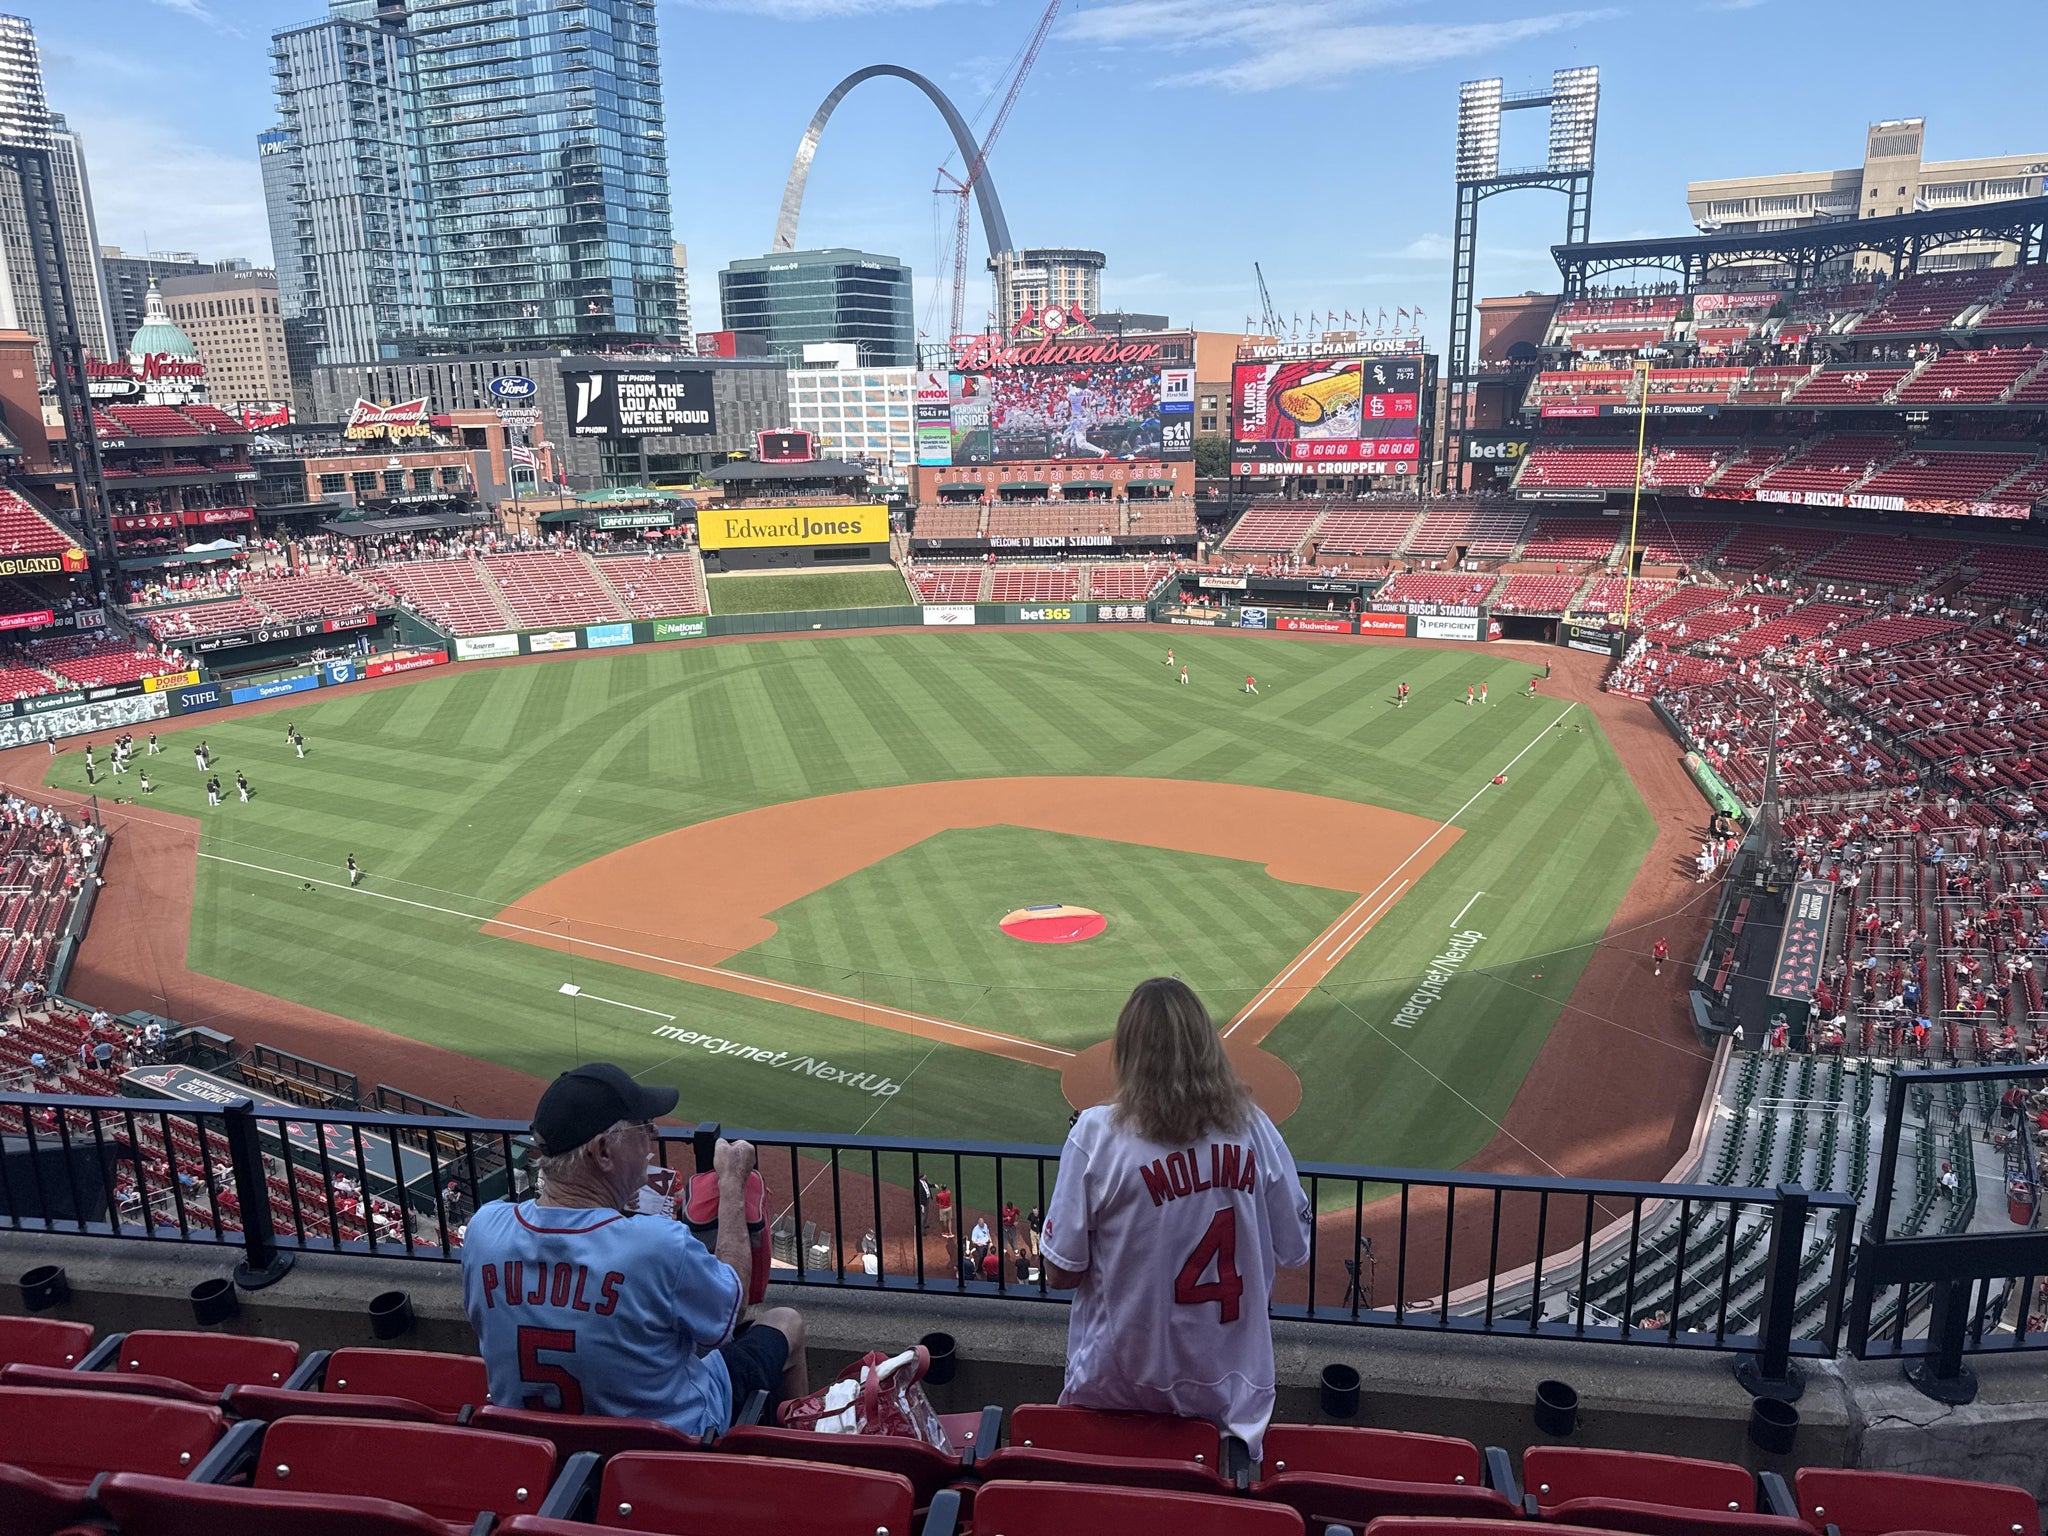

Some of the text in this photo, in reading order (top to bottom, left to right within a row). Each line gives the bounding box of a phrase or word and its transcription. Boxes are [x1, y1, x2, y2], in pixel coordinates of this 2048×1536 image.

[1728, 294, 1777, 304] BUDWEISER
[950, 332, 1161, 371] Budweiser
[1252, 340, 1407, 358] WORLD CHAMPIONS
[135, 352, 204, 383] Nation
[145, 384, 194, 393] ROOFTOP
[499, 379, 529, 394] Ford
[617, 384, 685, 397] FROM THE
[918, 390, 948, 398] KMOX
[1256, 372, 1267, 425] CARDINALS
[619, 398, 677, 411] LOU AND
[955, 406, 988, 414] CARDINALS
[1243, 382, 1257, 432] ST. LOUIS
[1663, 405, 1704, 414] EDWARDS
[345, 407, 429, 424] Budweiser
[496, 408, 540, 418] Community
[619, 410, 709, 425] WE'RE PROUD
[955, 415, 989, 426] INSIDER
[348, 424, 431, 439] BREW HOUSE
[1313, 445, 1324, 455] GO
[1325, 445, 1336, 455] GO
[1337, 445, 1348, 454] GO
[1378, 444, 1389, 454] GO
[1390, 444, 1402, 454] GO
[1403, 444, 1414, 454] GO
[952, 470, 957, 481] 1
[962, 470, 969, 481] 2
[975, 469, 982, 480] 6
[988, 470, 995, 481] 9
[1000, 470, 1010, 481] 10
[1017, 470, 1028, 481] 14
[1034, 470, 1045, 481] 17
[1051, 470, 1063, 481] 20
[1072, 469, 1084, 480] 23
[1091, 469, 1104, 481] 24
[1110, 469, 1123, 480] 42
[1130, 468, 1143, 479] 45
[1259, 462, 1387, 474] BROWN & CROUPPEN
[1755, 490, 1904, 511] WELCOME TO BUSCH STADIUM
[603, 515, 670, 526] SAFETY NATIONAL
[725, 517, 862, 539] Edward Jones
[990, 536, 1112, 547] WELCOME TO BUSCH STADIUM
[17, 557, 61, 574] LAND
[1202, 577, 1242, 586] Schnucks
[1020, 607, 1070, 620] bet365
[1372, 603, 1478, 617] WELCOME TO BUSCH STADIUM
[0, 614, 46, 627] dinals.com
[340, 618, 367, 627] PURINA
[667, 621, 704, 632] National
[1300, 619, 1340, 631] Budweiser
[1428, 621, 1476, 630] PERFICIENT
[272, 630, 290, 639] 4:10
[473, 642, 496, 650] Ameren
[327, 658, 352, 669] CarShield
[394, 658, 435, 671] Budweiser
[156, 673, 189, 686] DOBBS
[260, 684, 292, 696] Spectrum
[36, 694, 86, 708] Central Bank
[181, 691, 219, 707] STIFEL
[1139, 1143, 1256, 1207] MOLINA
[1174, 1206, 1244, 1324] 4
[481, 1260, 625, 1317] PUJOLS
[517, 1325, 584, 1415] 5
